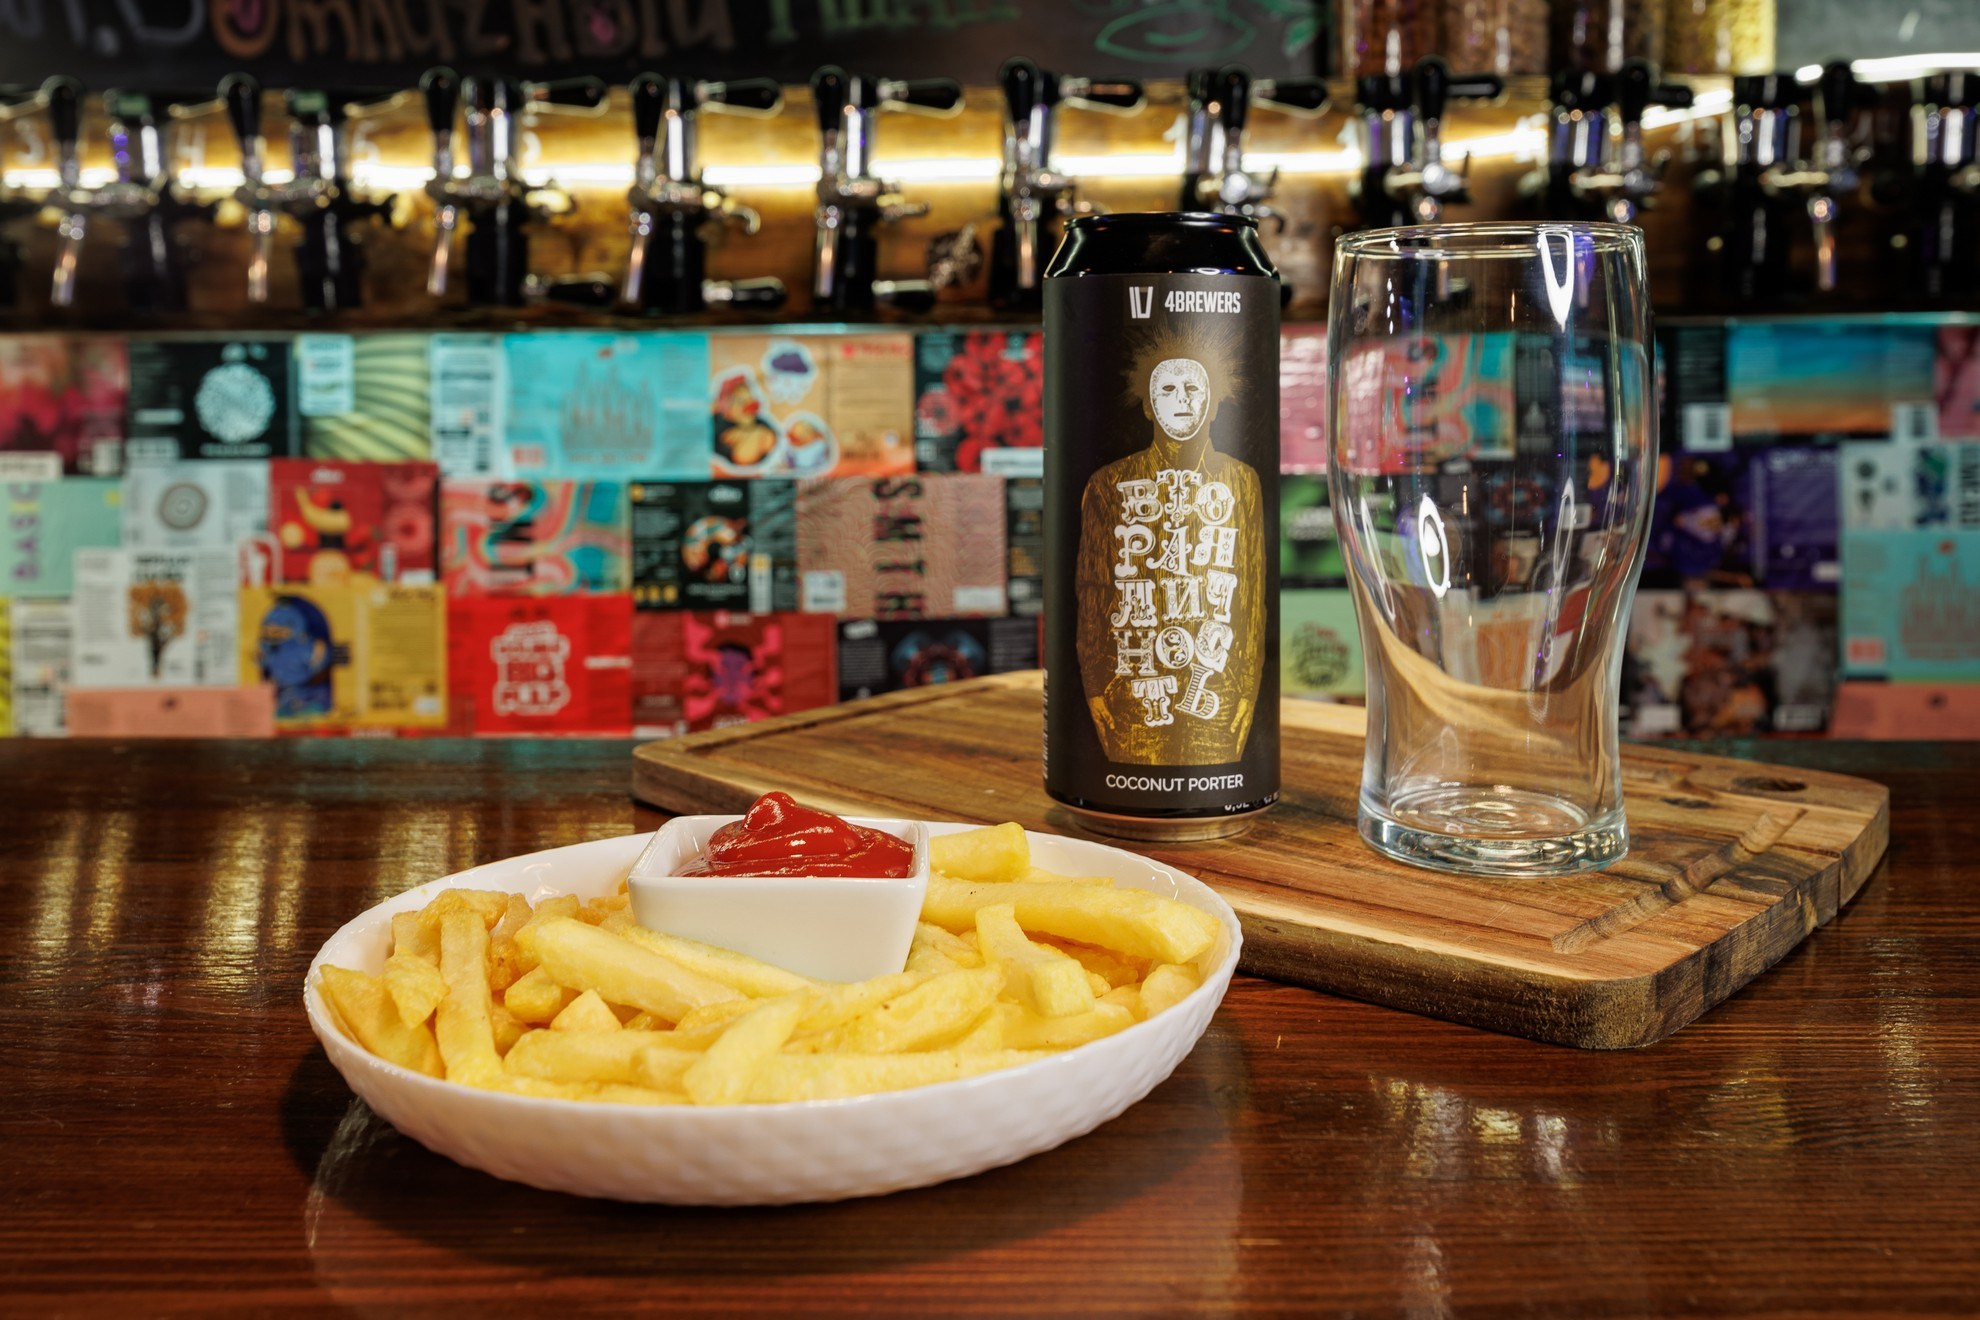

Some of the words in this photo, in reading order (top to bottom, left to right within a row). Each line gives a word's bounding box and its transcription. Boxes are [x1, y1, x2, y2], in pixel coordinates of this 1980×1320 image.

[1164, 290, 1241, 314] 4BREWERS
[1116, 469, 1235, 527] ВТО
[1113, 522, 1239, 578] РАЯ
[1112, 619, 1235, 677] НОС
[1130, 662, 1221, 727] ТЬ
[1106, 774, 1184, 792] COCONUT
[1188, 774, 1244, 791] PORTER
